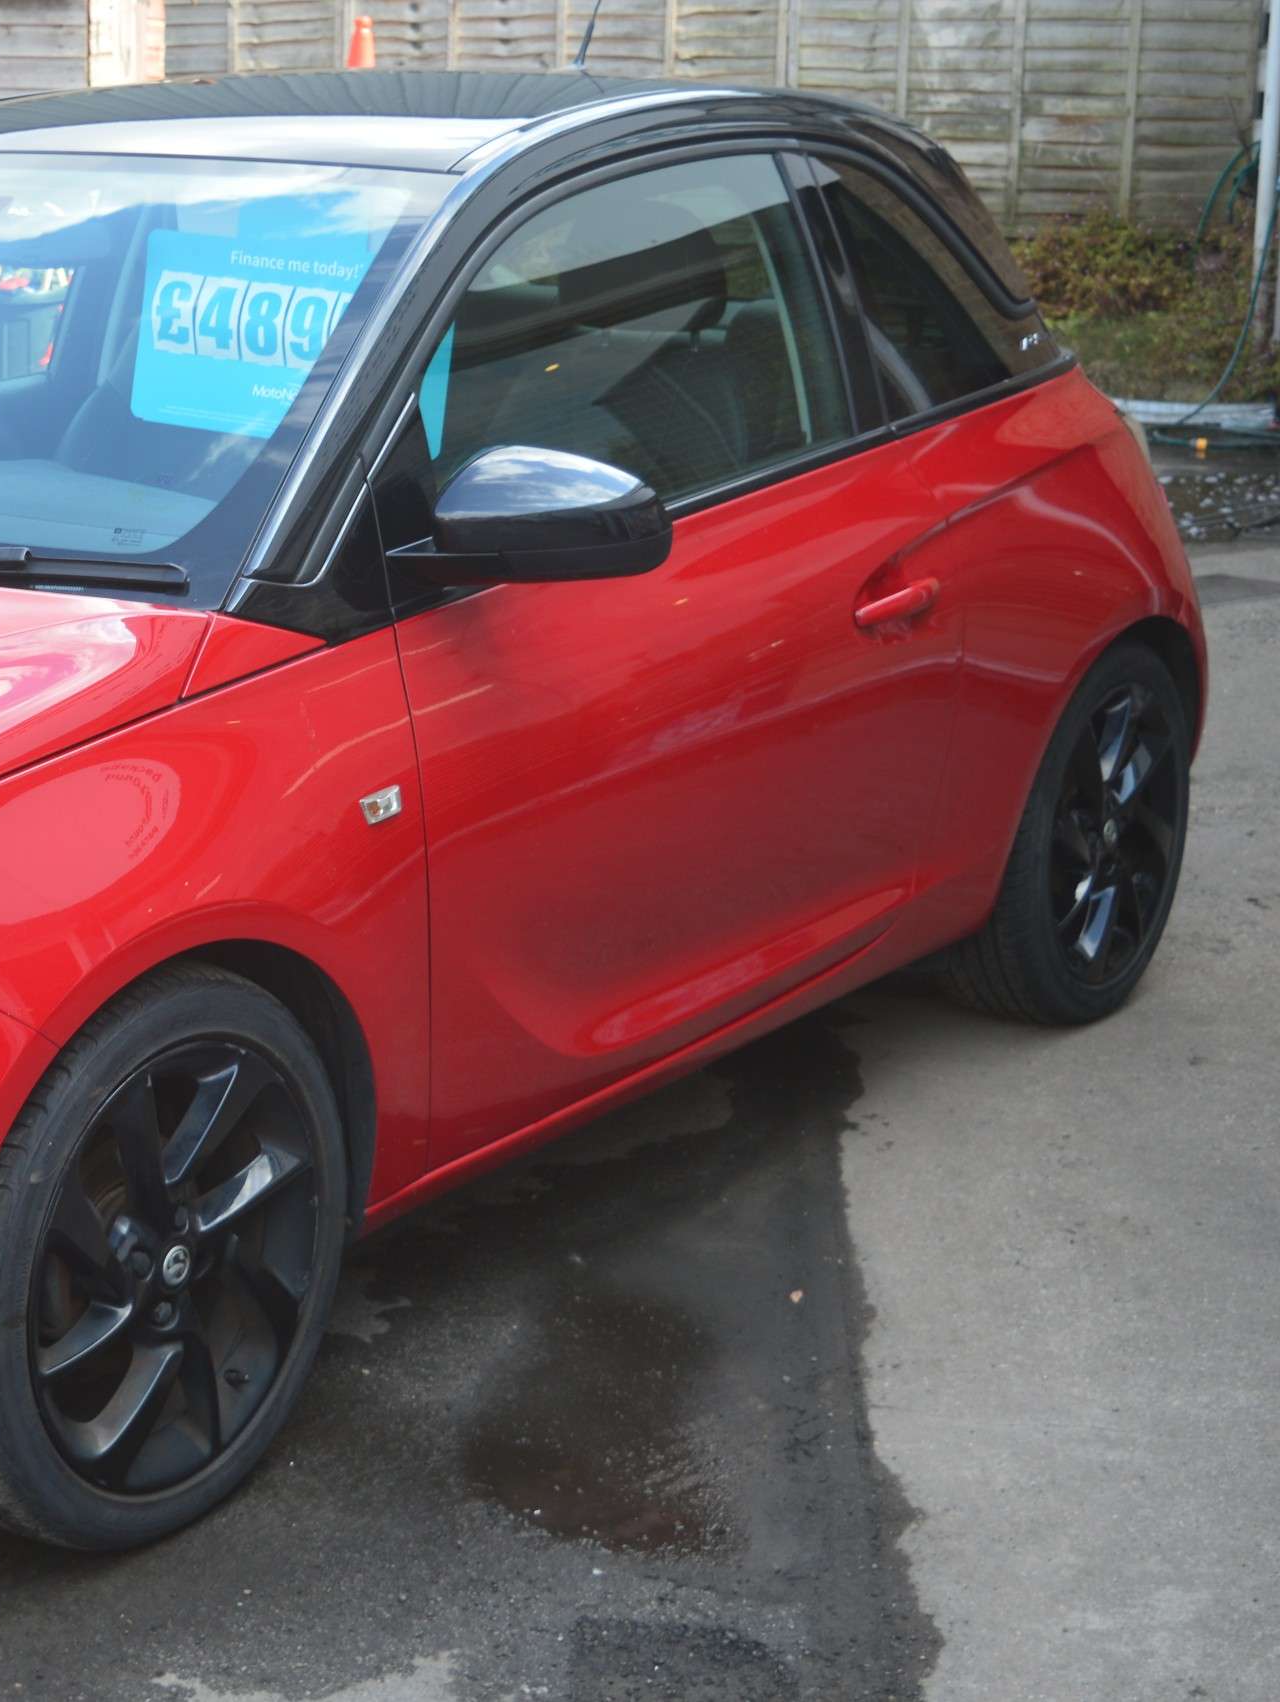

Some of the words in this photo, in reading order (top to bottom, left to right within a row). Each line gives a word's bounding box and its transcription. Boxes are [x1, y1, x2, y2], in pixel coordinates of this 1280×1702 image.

[230, 249, 285, 271] Finance
[288, 260, 310, 273] me
[156, 280, 350, 361] £489
